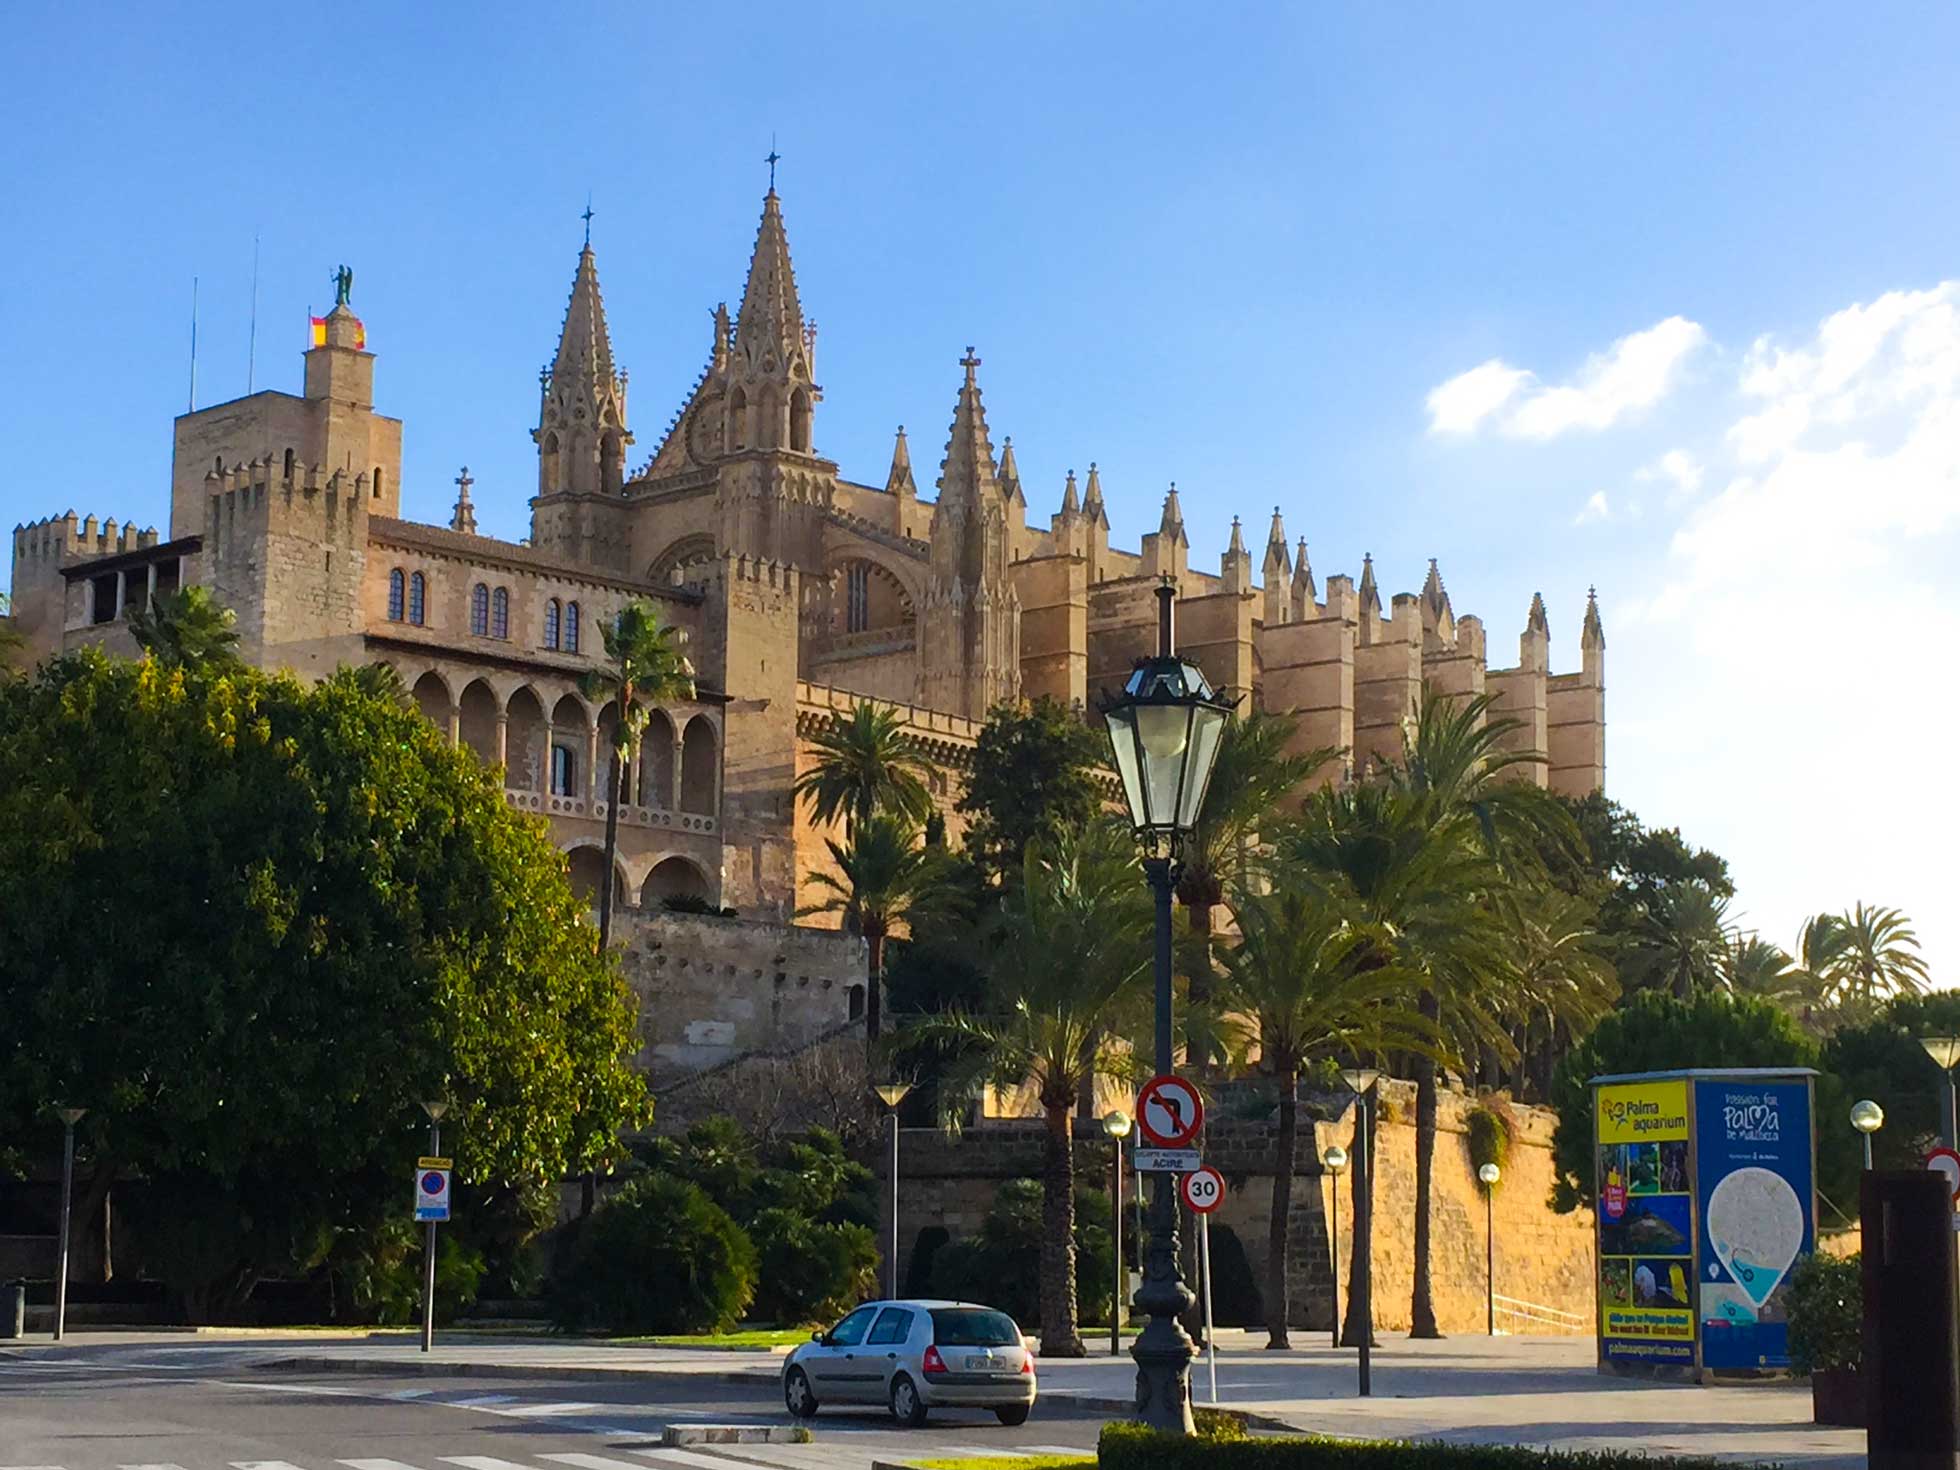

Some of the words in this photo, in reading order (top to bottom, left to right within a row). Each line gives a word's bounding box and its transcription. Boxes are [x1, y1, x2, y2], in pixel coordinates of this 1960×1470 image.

[1626, 1100, 1659, 1115] Palma
[1633, 1115, 1685, 1133] aquarium
[1152, 1158, 1184, 1168] ACIRE
[1192, 1181, 1215, 1197] 30
